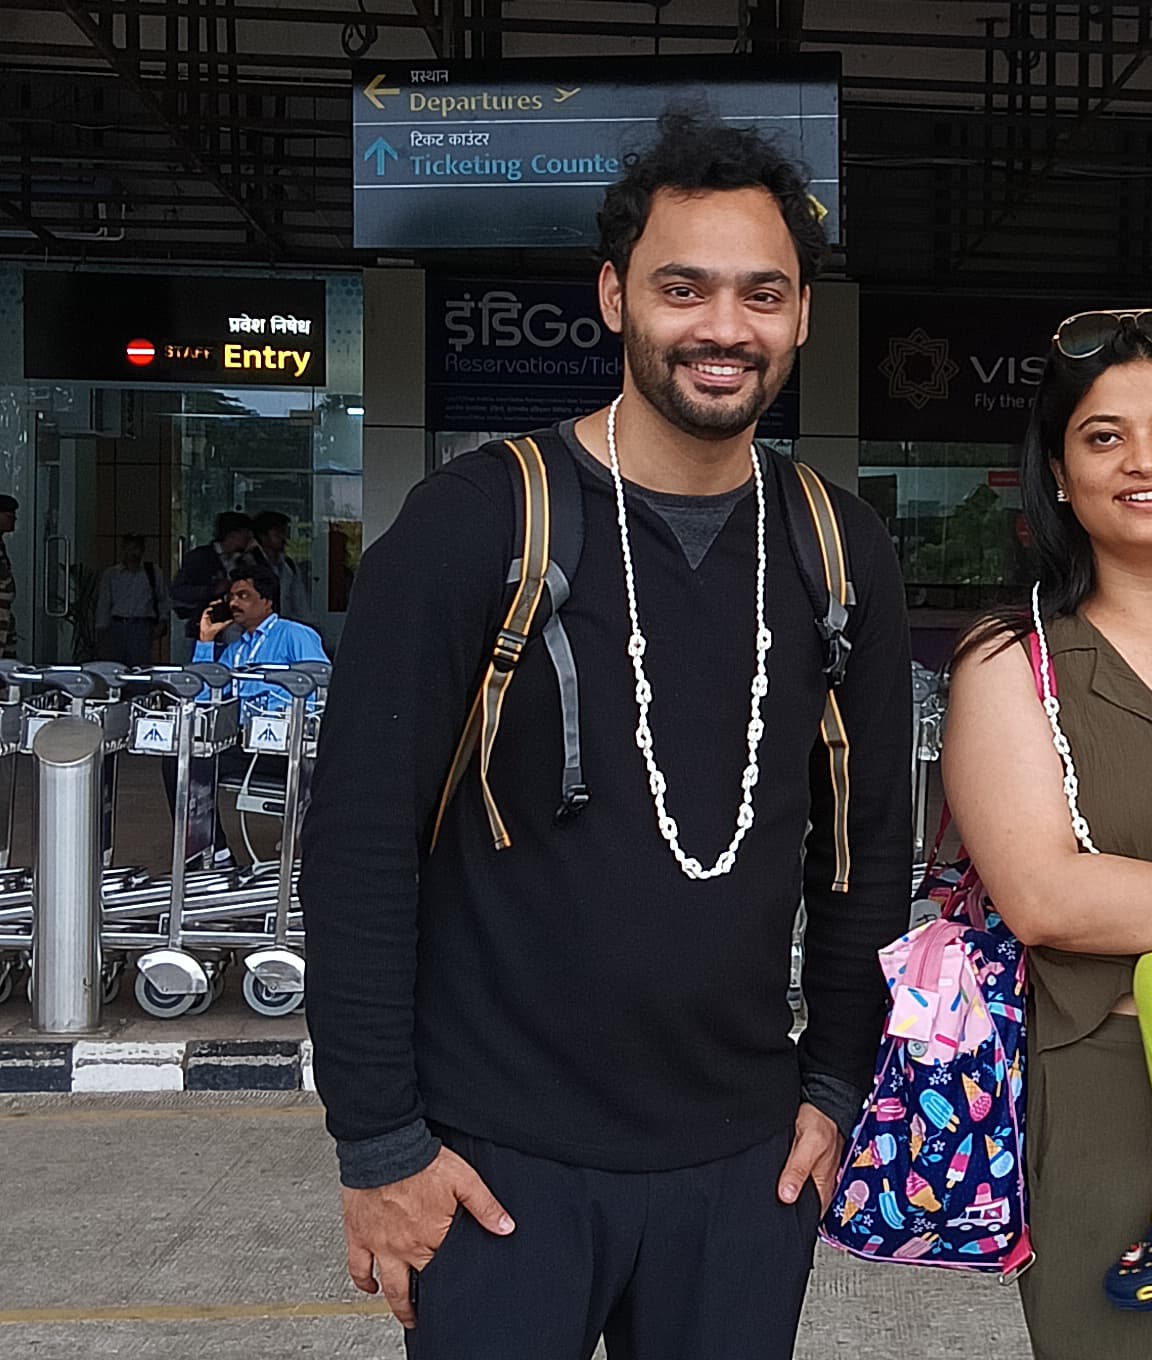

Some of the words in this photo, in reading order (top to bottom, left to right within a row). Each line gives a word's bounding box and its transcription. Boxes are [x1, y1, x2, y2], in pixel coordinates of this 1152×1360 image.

[410, 69, 449, 84] प्रस्थान
[409, 93, 543, 117] Departures
[410, 131, 444, 148] टिकट
[448, 130, 490, 146] काउंटर
[409, 154, 522, 180] Ticketing
[531, 154, 618, 175] Counte
[228, 313, 266, 334] प्रवेश
[269, 315, 312, 335] निषेध
[224, 344, 311, 378] Entry
[974, 393, 995, 412] Fly
[999, 393, 1024, 409] the
